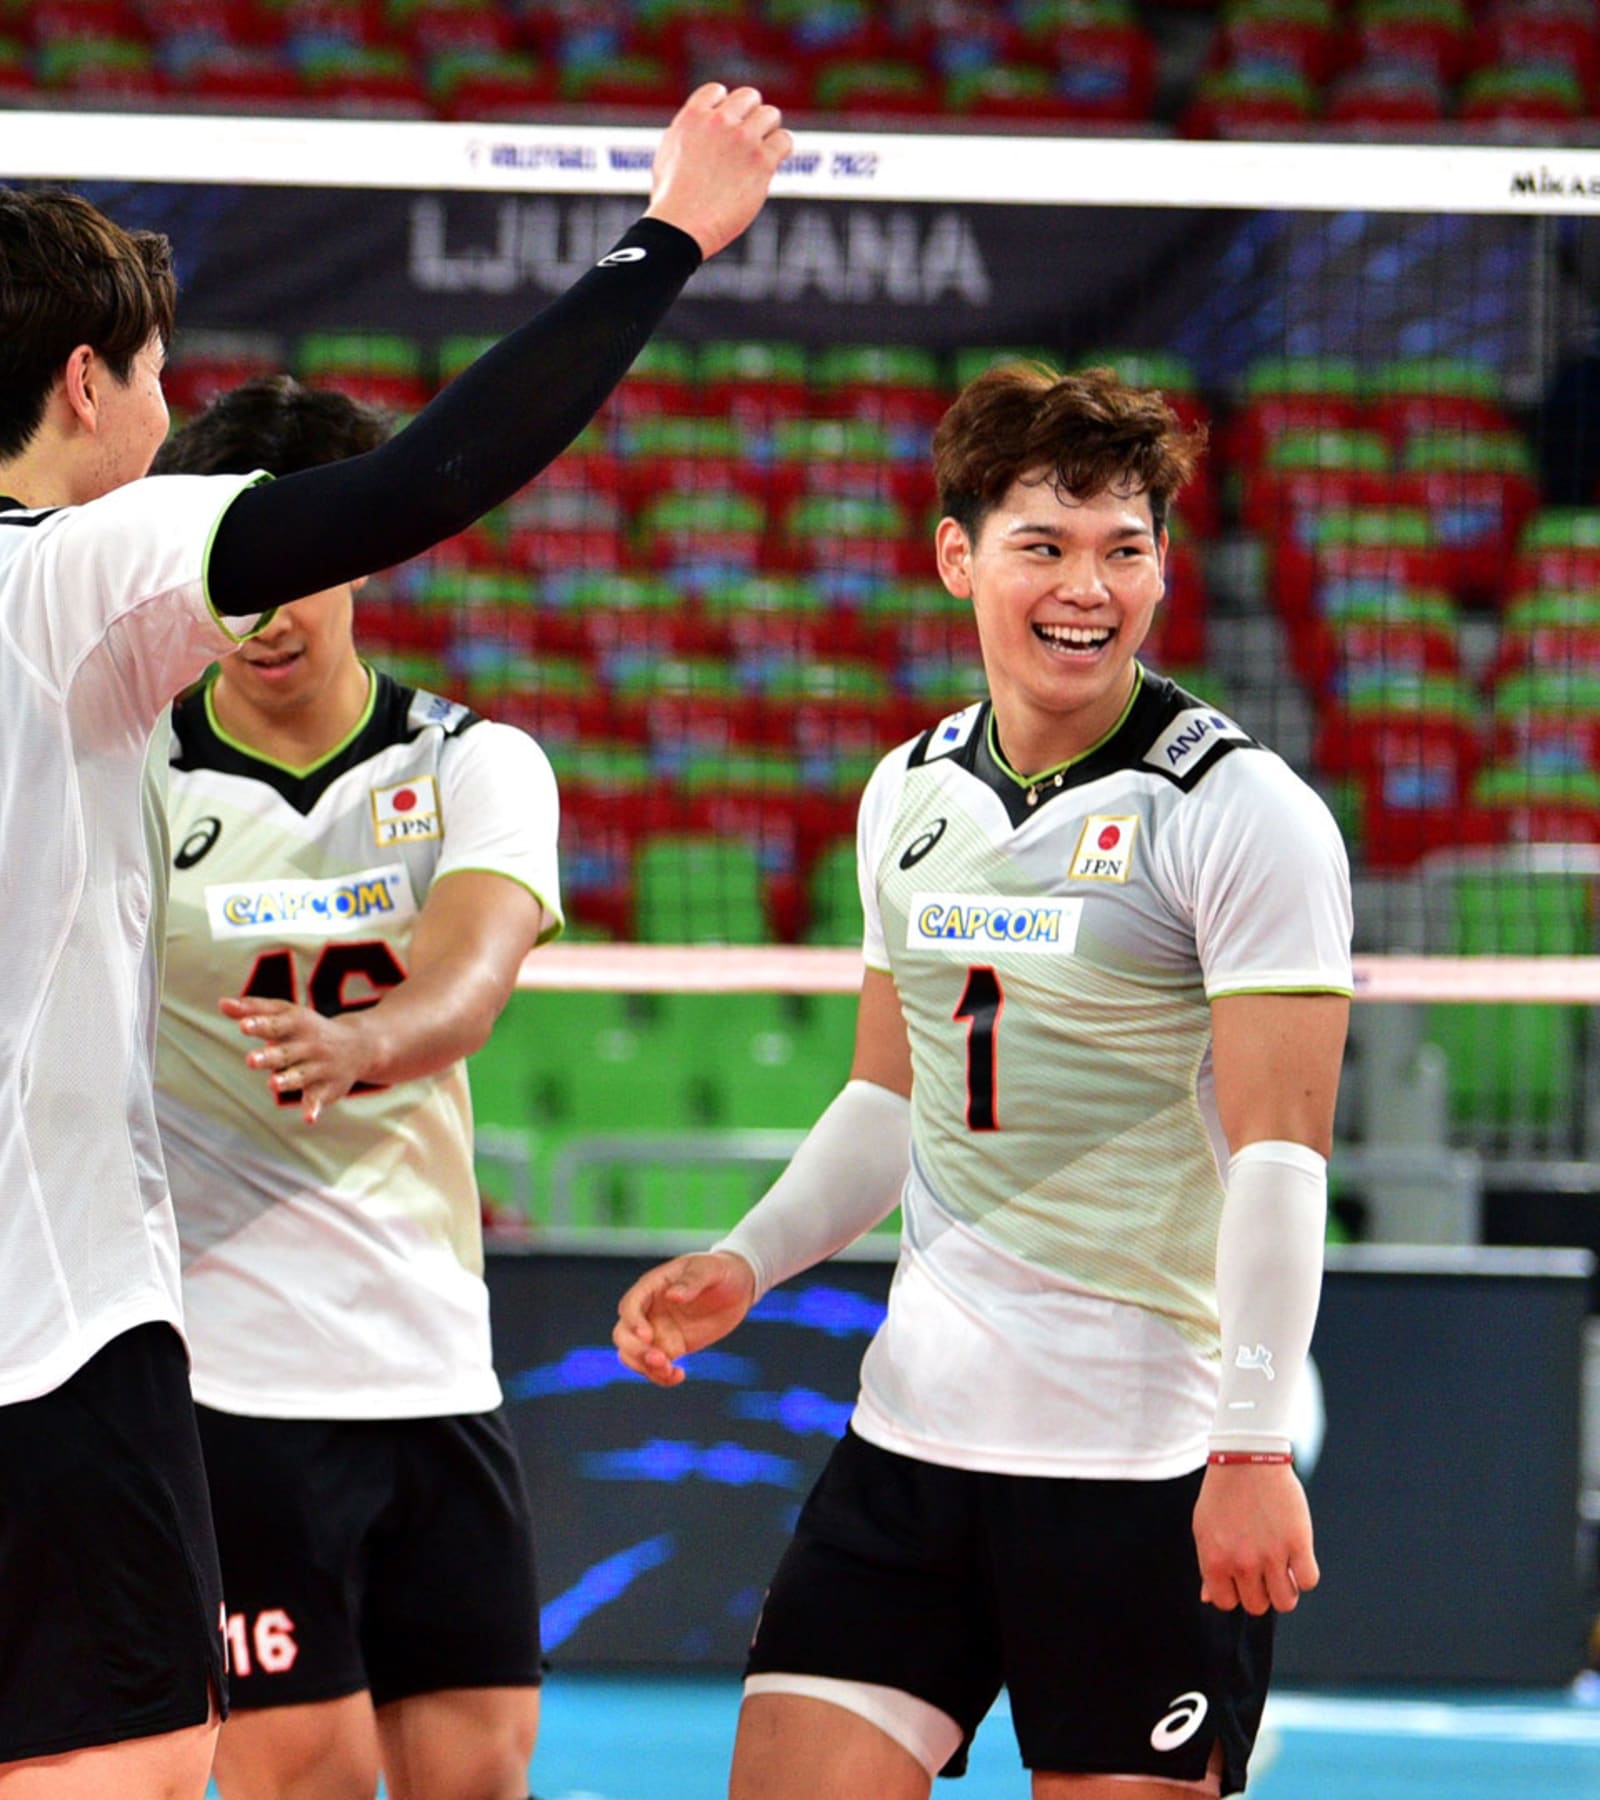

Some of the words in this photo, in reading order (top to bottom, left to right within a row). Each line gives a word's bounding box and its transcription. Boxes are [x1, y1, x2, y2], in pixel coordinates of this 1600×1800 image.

[1166, 719, 1211, 766] ANA
[387, 817, 432, 838] JPN
[1080, 858, 1123, 875] JPN
[225, 878, 394, 926] CAPCOM
[918, 903, 1061, 943] CAPCOM
[952, 964, 1005, 1133] 1
[228, 1609, 298, 1677] 16
